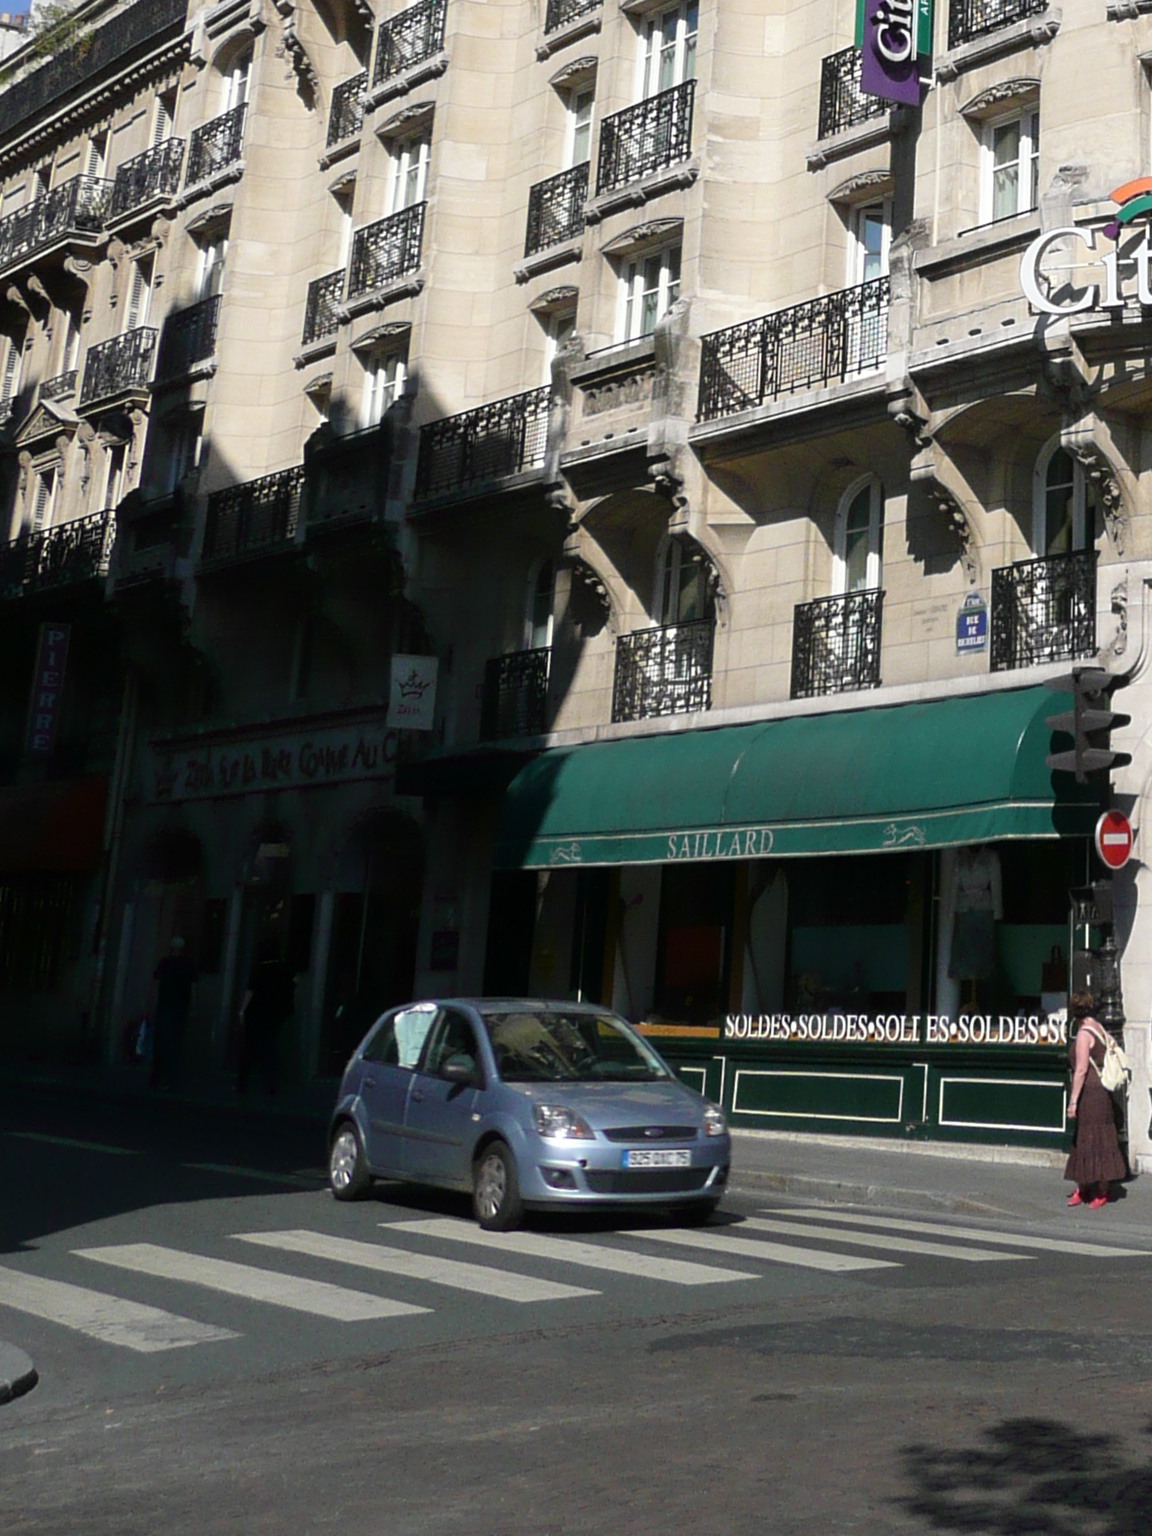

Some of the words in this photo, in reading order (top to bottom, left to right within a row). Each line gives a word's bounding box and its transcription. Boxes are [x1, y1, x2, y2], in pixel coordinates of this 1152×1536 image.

[967, 615, 979, 625] RUE
[32, 630, 65, 750] PIERRE
[667, 830, 774, 858] SAILLARD
